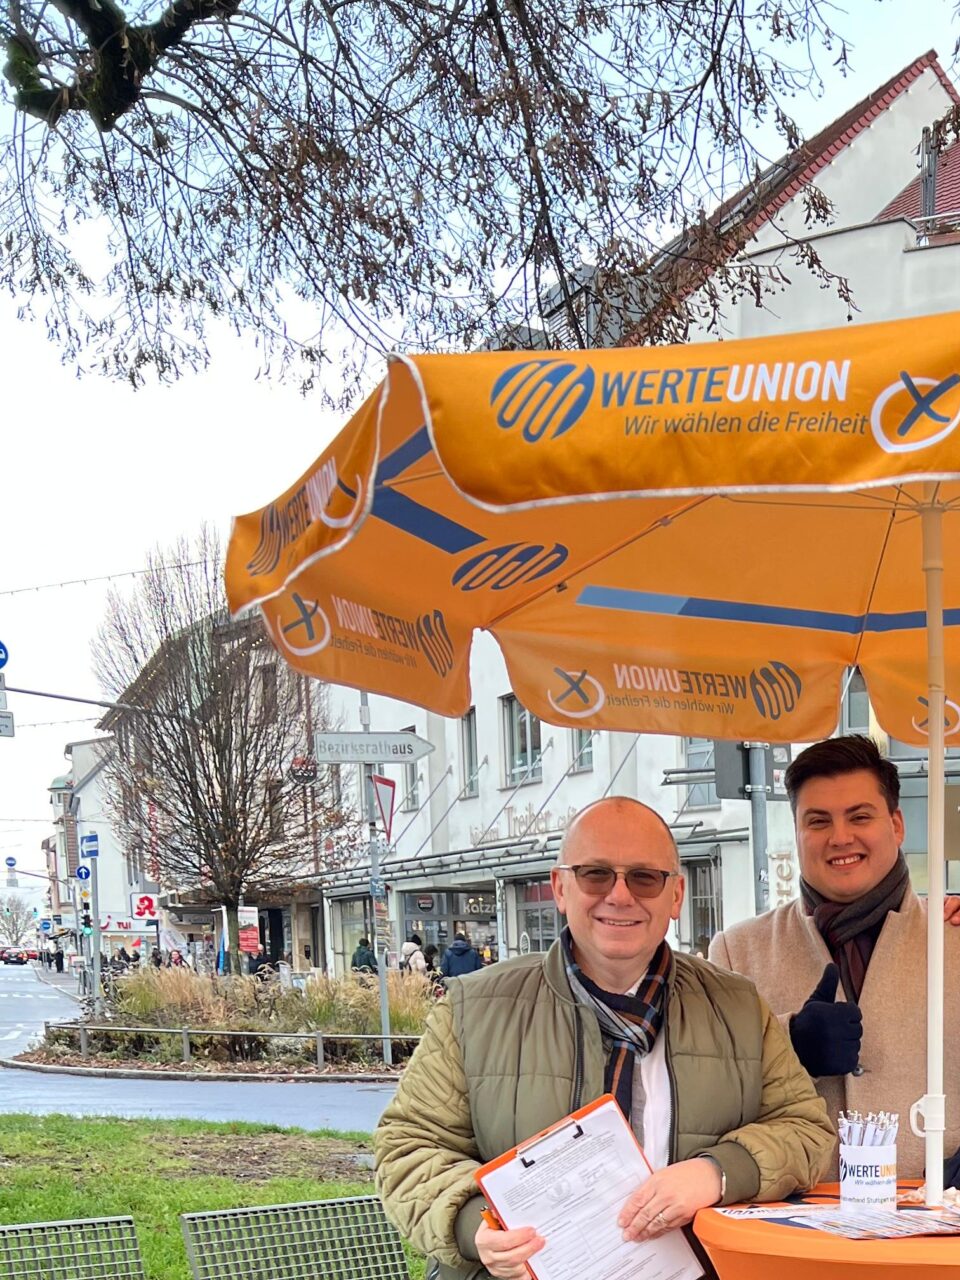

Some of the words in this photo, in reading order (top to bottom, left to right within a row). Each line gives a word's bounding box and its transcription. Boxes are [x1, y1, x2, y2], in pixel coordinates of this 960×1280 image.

[601, 360, 851, 408] WERTEUNION
[625, 415, 658, 436] Wir
[664, 411, 741, 434] wählen
[747, 411, 780, 432] die
[785, 411, 868, 434] Freiheit
[320, 740, 414, 755] Bezirksrathaus
